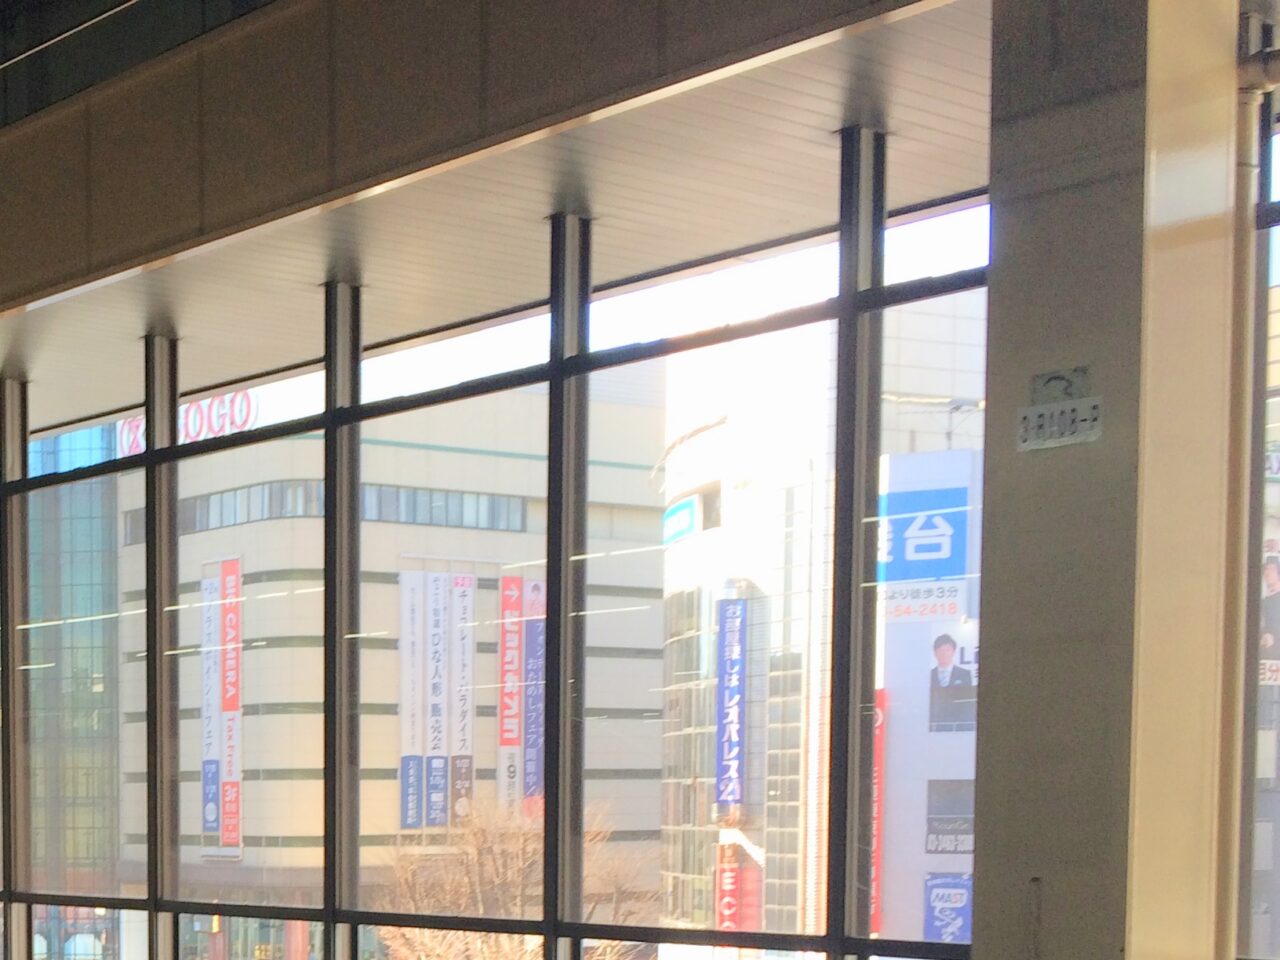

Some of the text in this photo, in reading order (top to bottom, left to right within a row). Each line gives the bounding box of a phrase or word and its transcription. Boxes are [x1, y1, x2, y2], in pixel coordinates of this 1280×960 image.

[181, 389, 254, 446] OGO
[225, 575, 237, 699] BIC CAMERA
